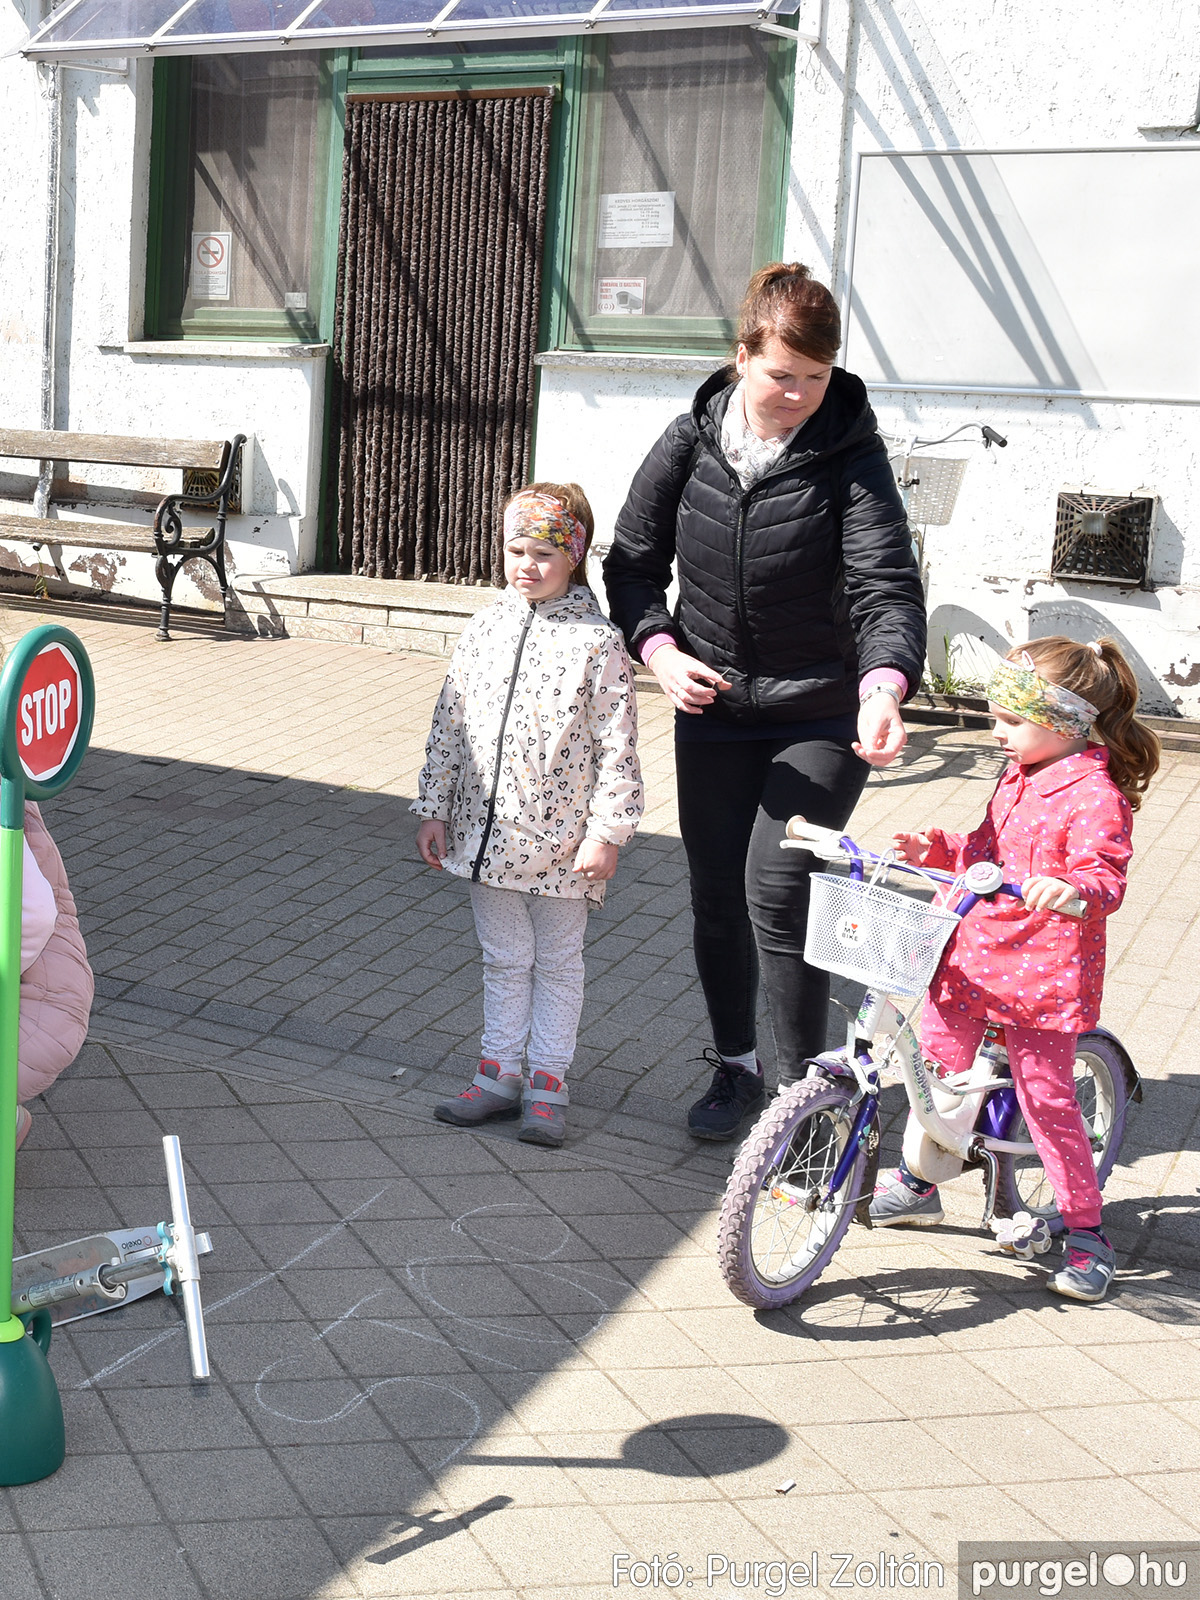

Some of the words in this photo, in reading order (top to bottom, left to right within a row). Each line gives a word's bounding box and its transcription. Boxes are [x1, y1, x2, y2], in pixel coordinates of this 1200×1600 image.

[21, 678, 72, 746] STOP
[841, 932, 859, 942] BIKE
[121, 1238, 143, 1250] oxelo
